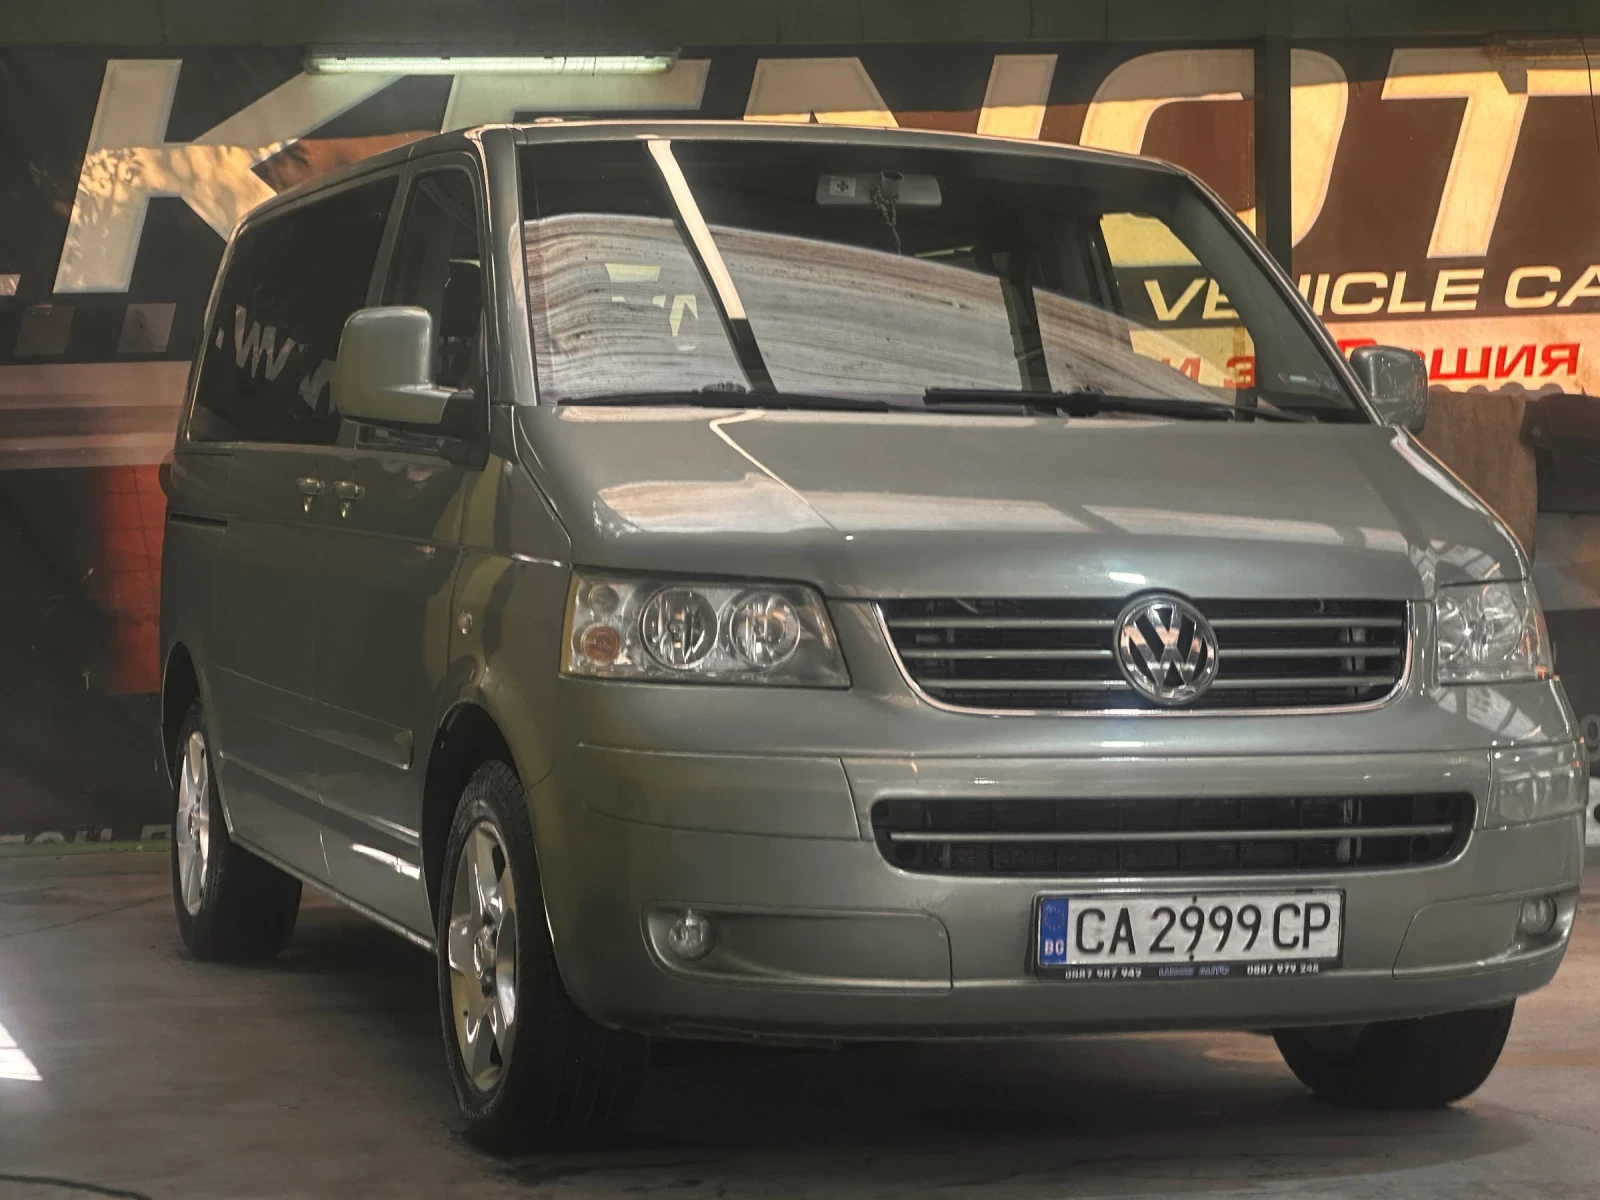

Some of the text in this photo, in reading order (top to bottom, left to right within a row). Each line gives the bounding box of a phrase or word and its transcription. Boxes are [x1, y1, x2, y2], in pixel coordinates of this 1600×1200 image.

[1144, 268, 1484, 322] VEICLE
[1075, 901, 1331, 955] CA 2999 CP
[1044, 938, 1065, 956] BG
[1065, 967, 1092, 979] 0887
[1246, 963, 1273, 975] 0887
